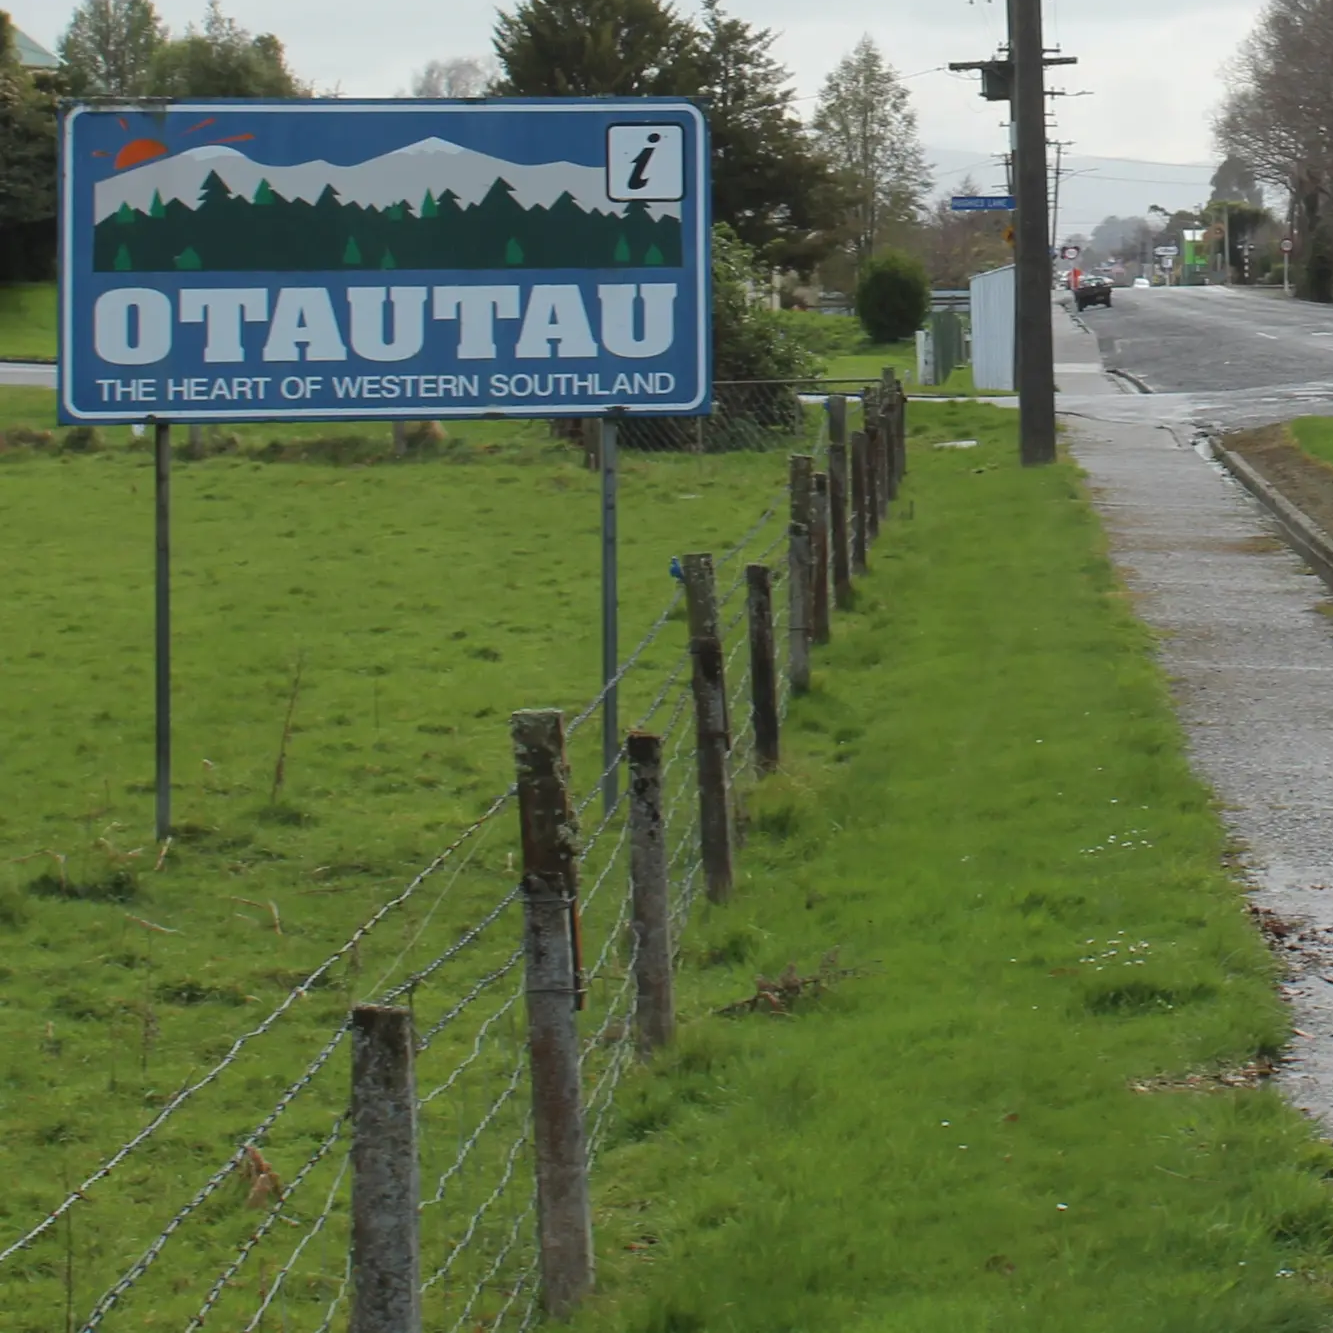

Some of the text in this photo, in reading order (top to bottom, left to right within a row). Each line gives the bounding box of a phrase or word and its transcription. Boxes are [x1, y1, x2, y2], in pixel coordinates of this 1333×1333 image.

[94, 282, 678, 365] OTAUTAU
[95, 371, 676, 402] THE HEART OF WESTERN SOUTHLAND
